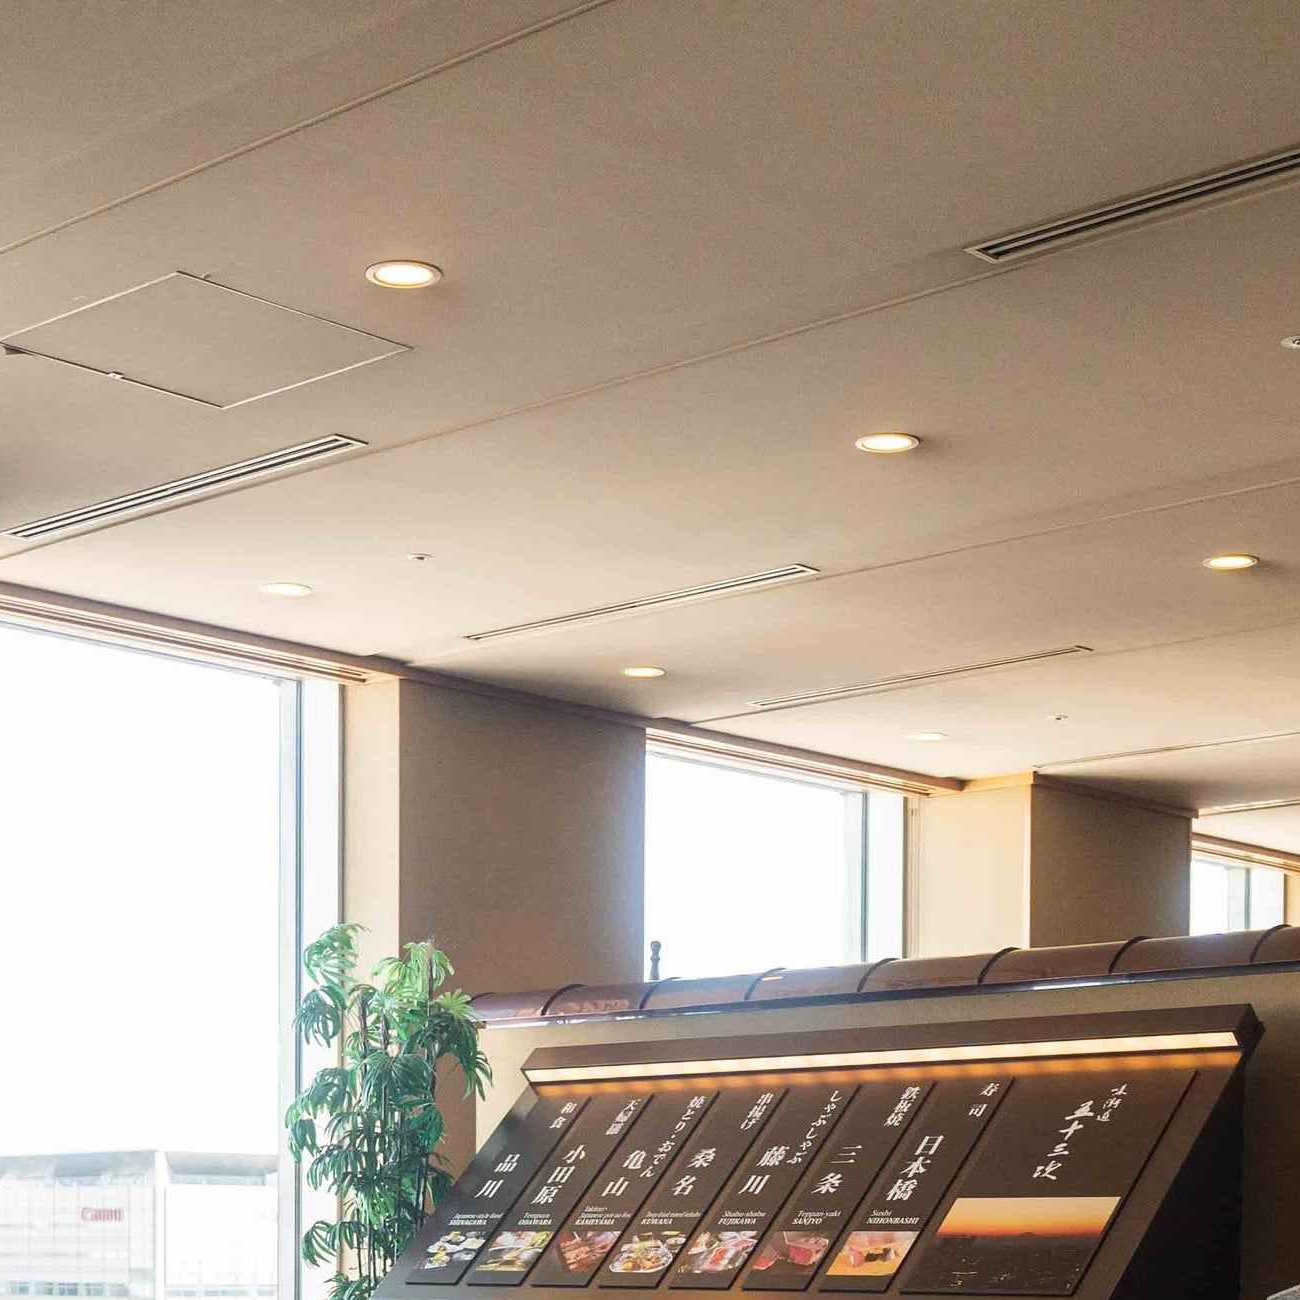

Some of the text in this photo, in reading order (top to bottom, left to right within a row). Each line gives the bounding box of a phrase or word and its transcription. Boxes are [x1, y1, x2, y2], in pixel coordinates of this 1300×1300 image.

[550, 1101, 577, 1128] 和食
[740, 1093, 773, 1130] 串揚げ
[883, 1086, 920, 1127] 鉄板焼
[968, 1083, 1000, 1117] 寿司
[786, 1090, 843, 1165] しゃぶしゃぶ
[1033, 1100, 1095, 1180] 五十三次
[475, 1153, 520, 1198] 品川
[531, 1145, 586, 1204] 小田原
[602, 1150, 647, 1197] 亀山
[672, 1148, 717, 1196] 桑名
[738, 1146, 790, 1195] 藤川
[811, 1145, 862, 1194] 三条
[886, 1135, 945, 1201] 日本橋
[797, 1210, 842, 1219] Teppan-yaki
